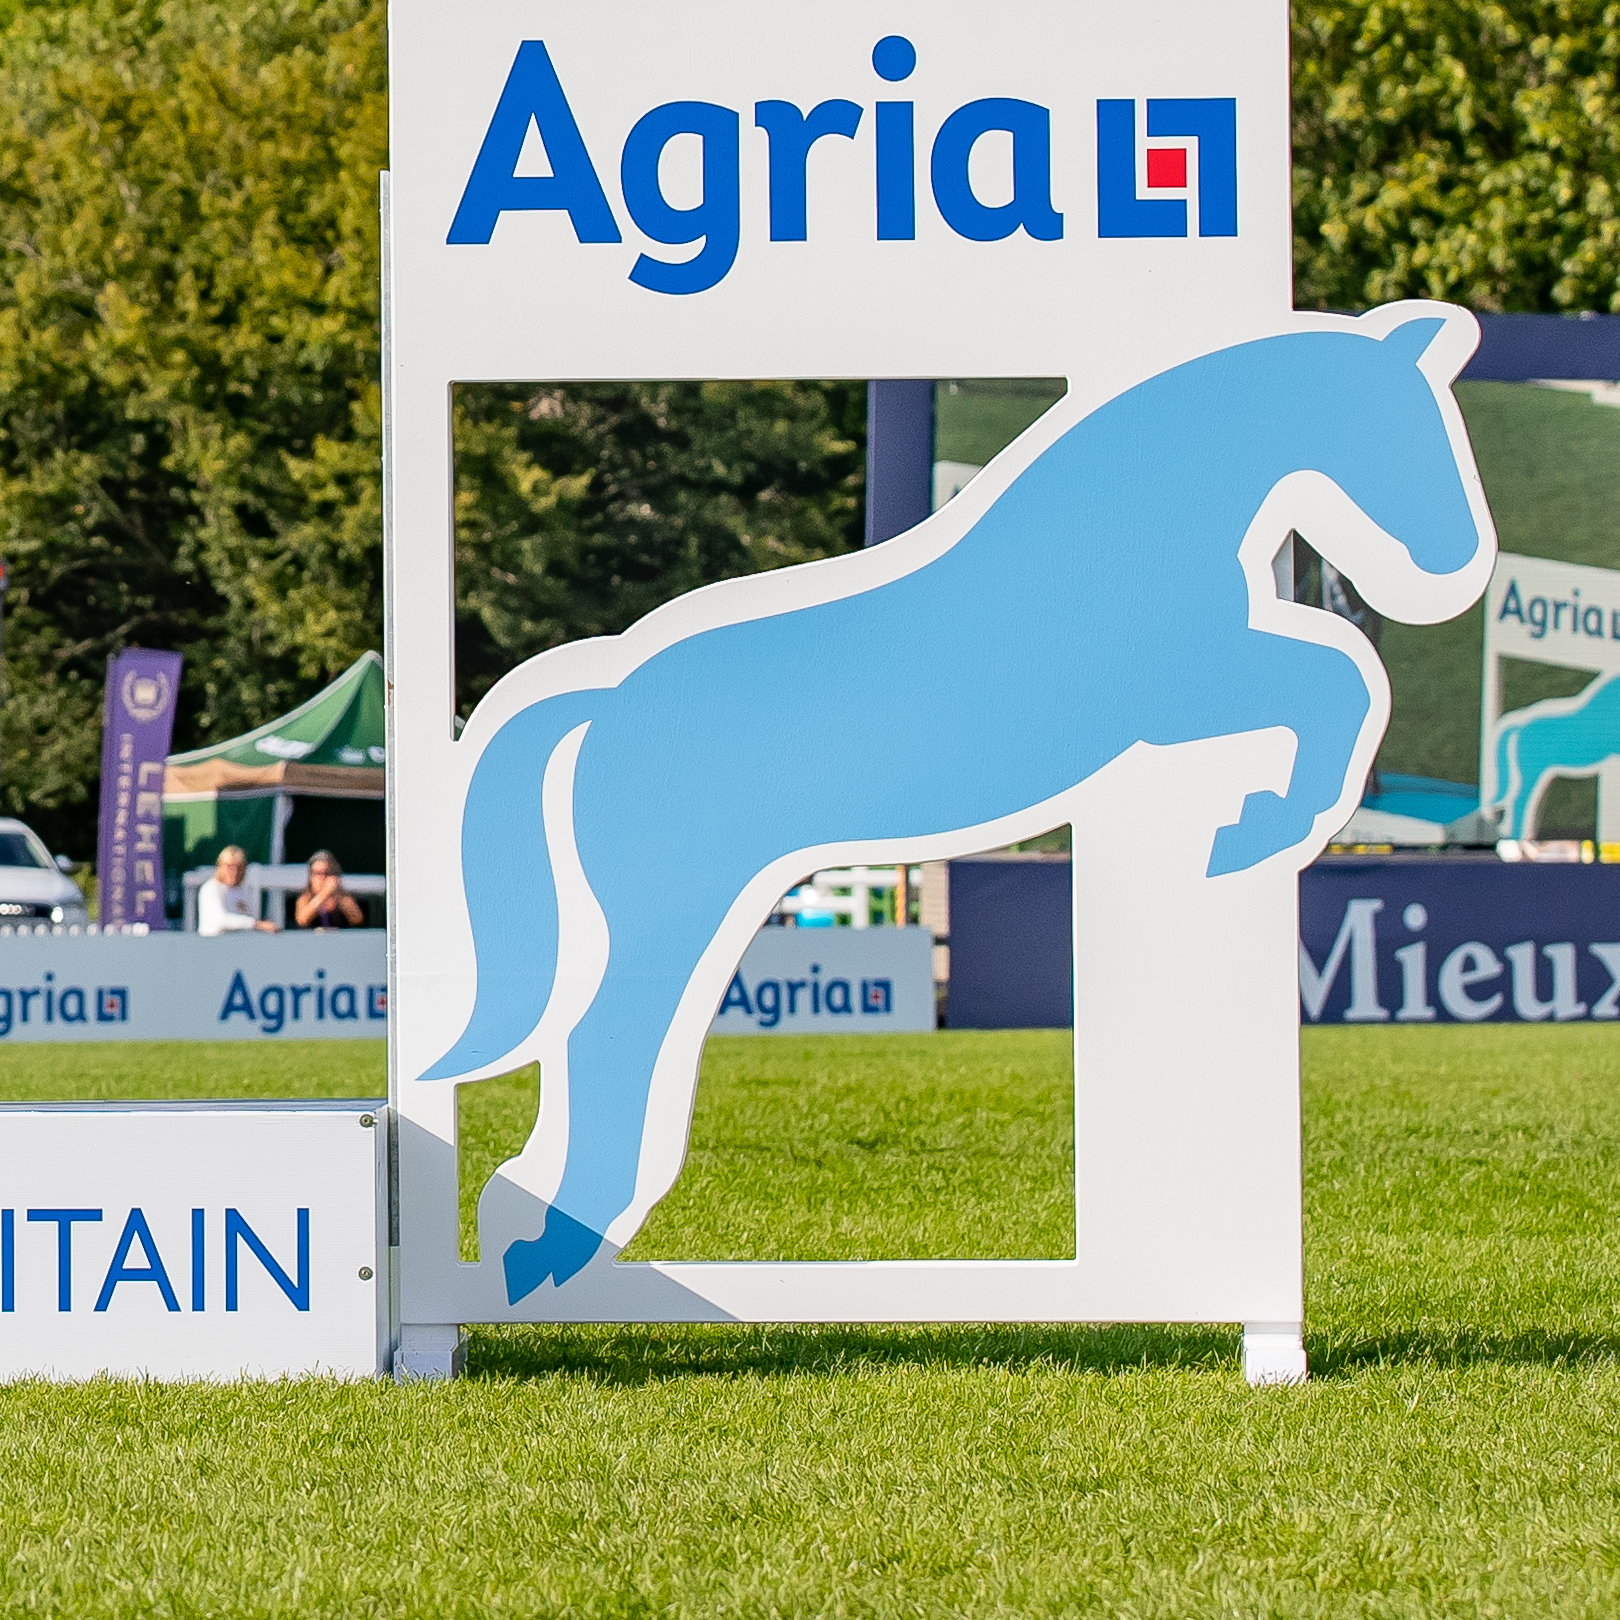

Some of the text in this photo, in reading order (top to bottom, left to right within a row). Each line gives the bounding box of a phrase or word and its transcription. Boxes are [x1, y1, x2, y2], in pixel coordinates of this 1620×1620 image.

[446, 35, 1064, 295] Agria
[1499, 577, 1604, 639] Agria
[134, 762, 163, 916] LEHEL
[219, 969, 358, 1034] Agria
[719, 963, 852, 1027] Agria
